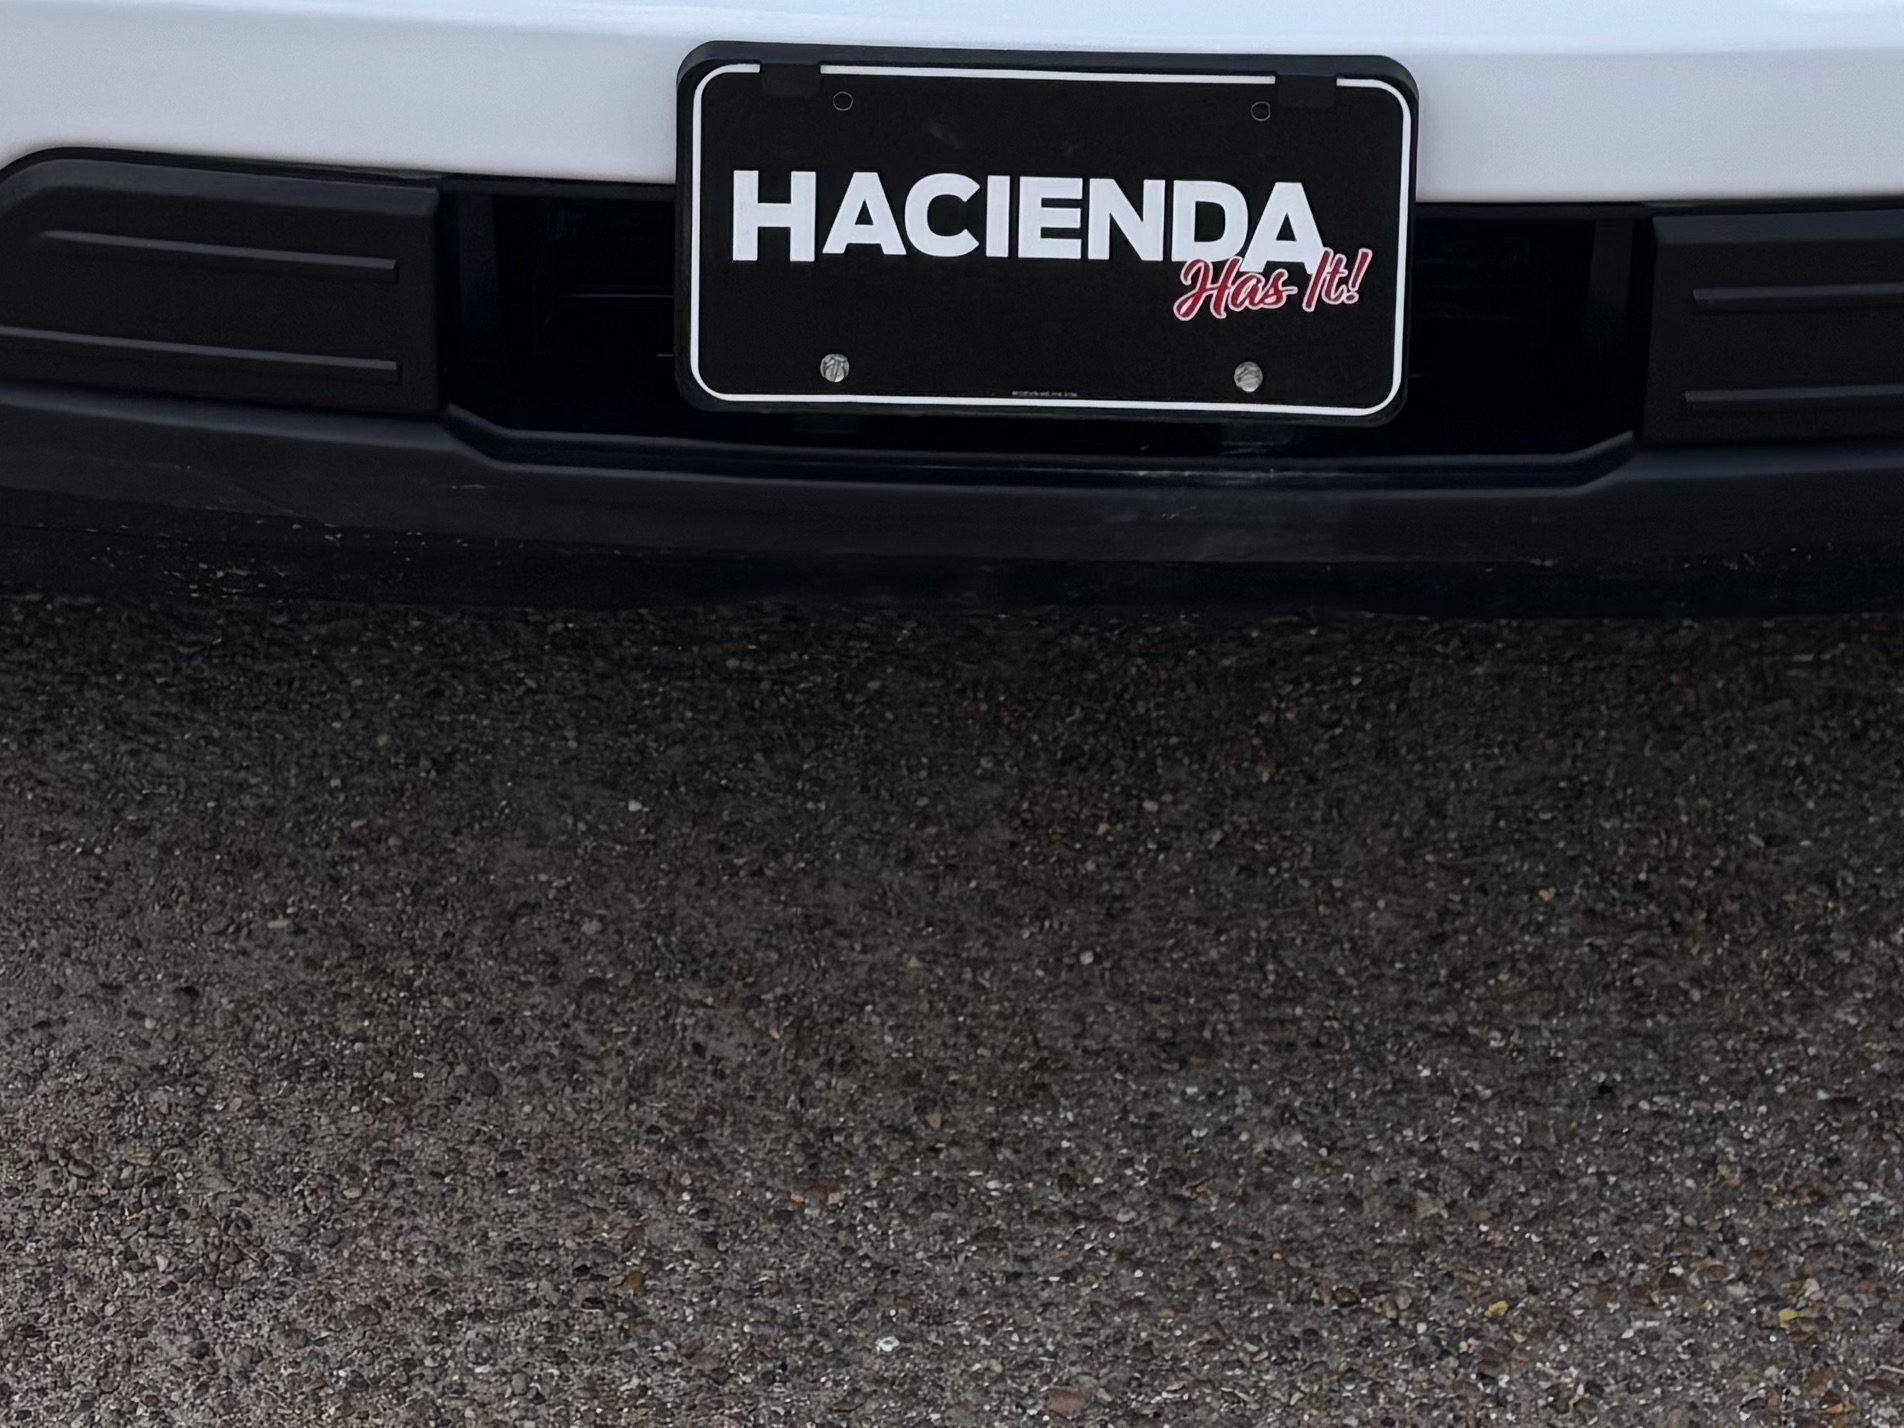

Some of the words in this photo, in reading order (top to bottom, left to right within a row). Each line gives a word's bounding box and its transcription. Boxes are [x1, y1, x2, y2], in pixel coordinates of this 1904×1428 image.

[731, 169, 1326, 274] HACIENDA
[1173, 255, 1298, 322] Has
[1302, 246, 1373, 313] It!
